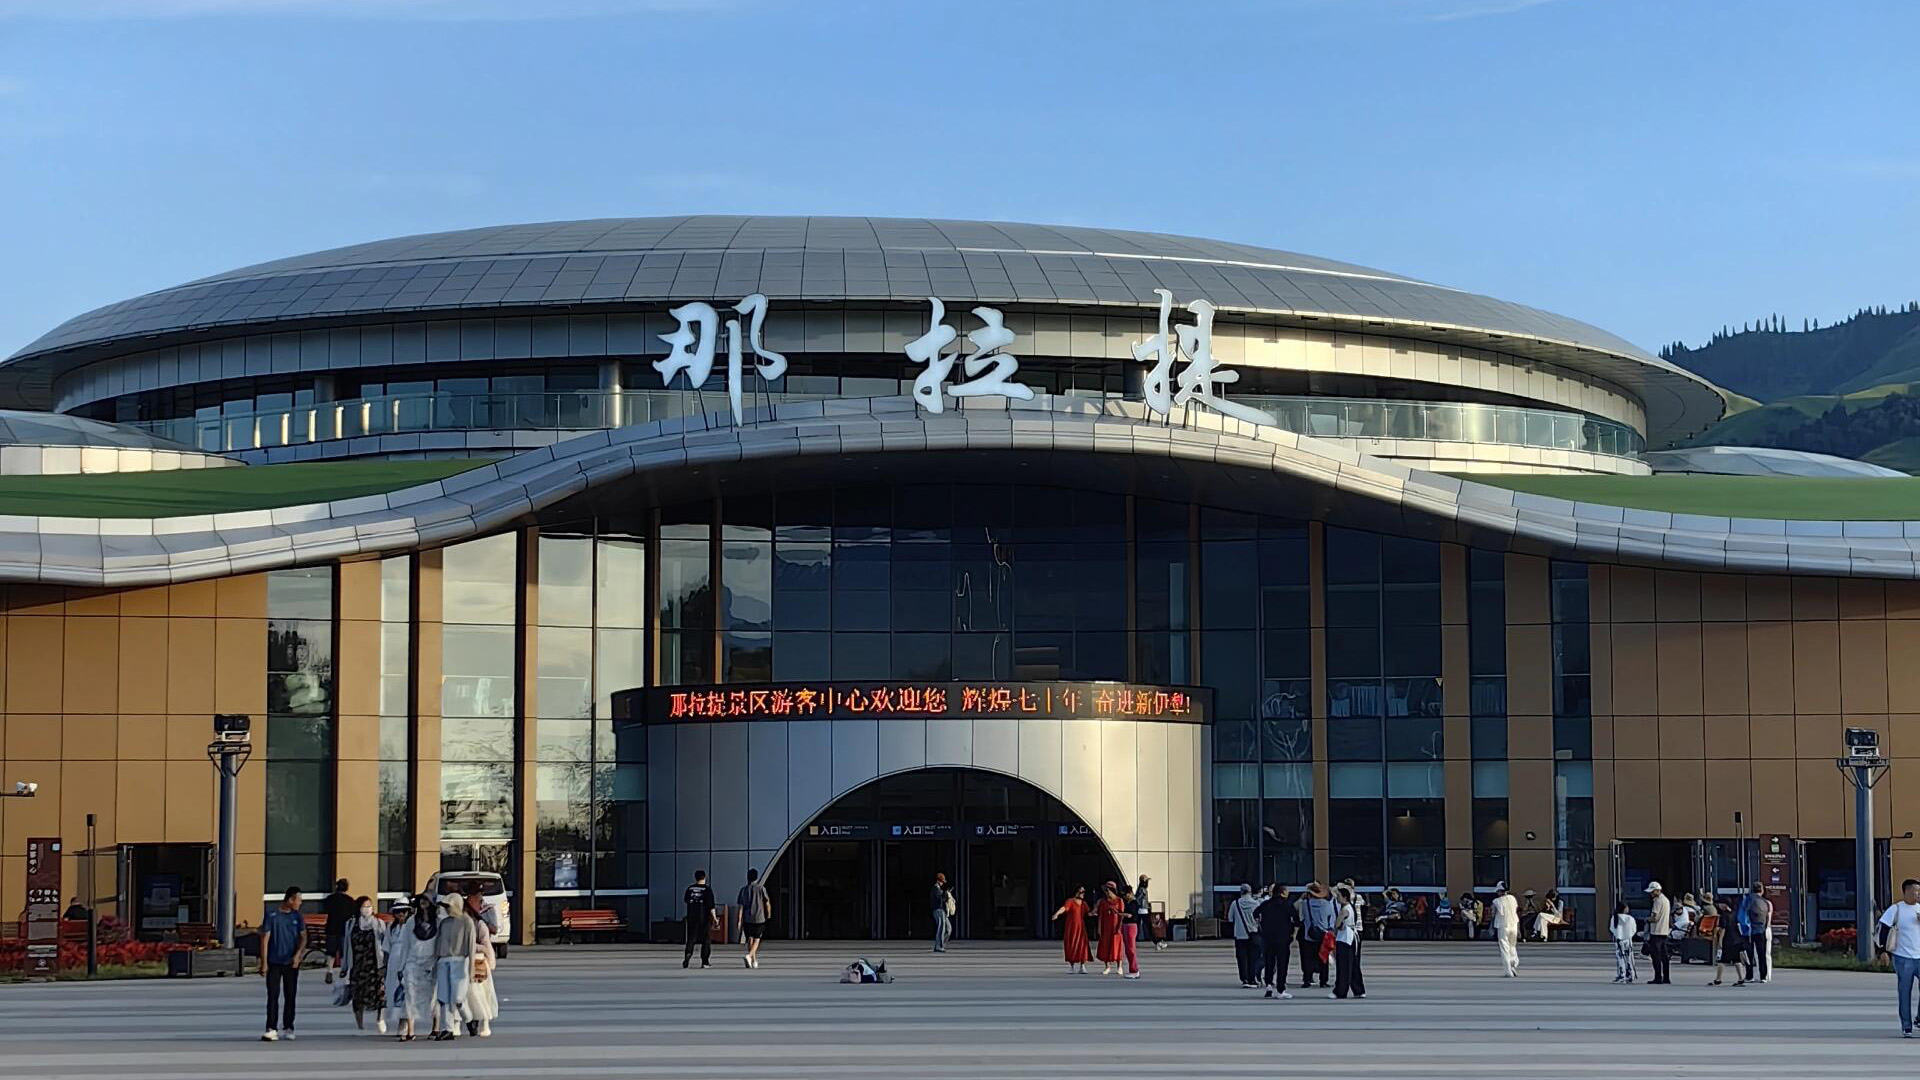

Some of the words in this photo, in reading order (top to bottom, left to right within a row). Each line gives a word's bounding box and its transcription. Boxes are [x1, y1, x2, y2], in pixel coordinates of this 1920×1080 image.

[652, 288, 1276, 427] 那拉提
[669, 687, 948, 718] 那拉提景区游客中心欢迎您
[820, 825, 839, 835] 入口
[903, 825, 922, 835] 入口
[986, 825, 1006, 835] 入口
[1069, 825, 1088, 835] 入口
